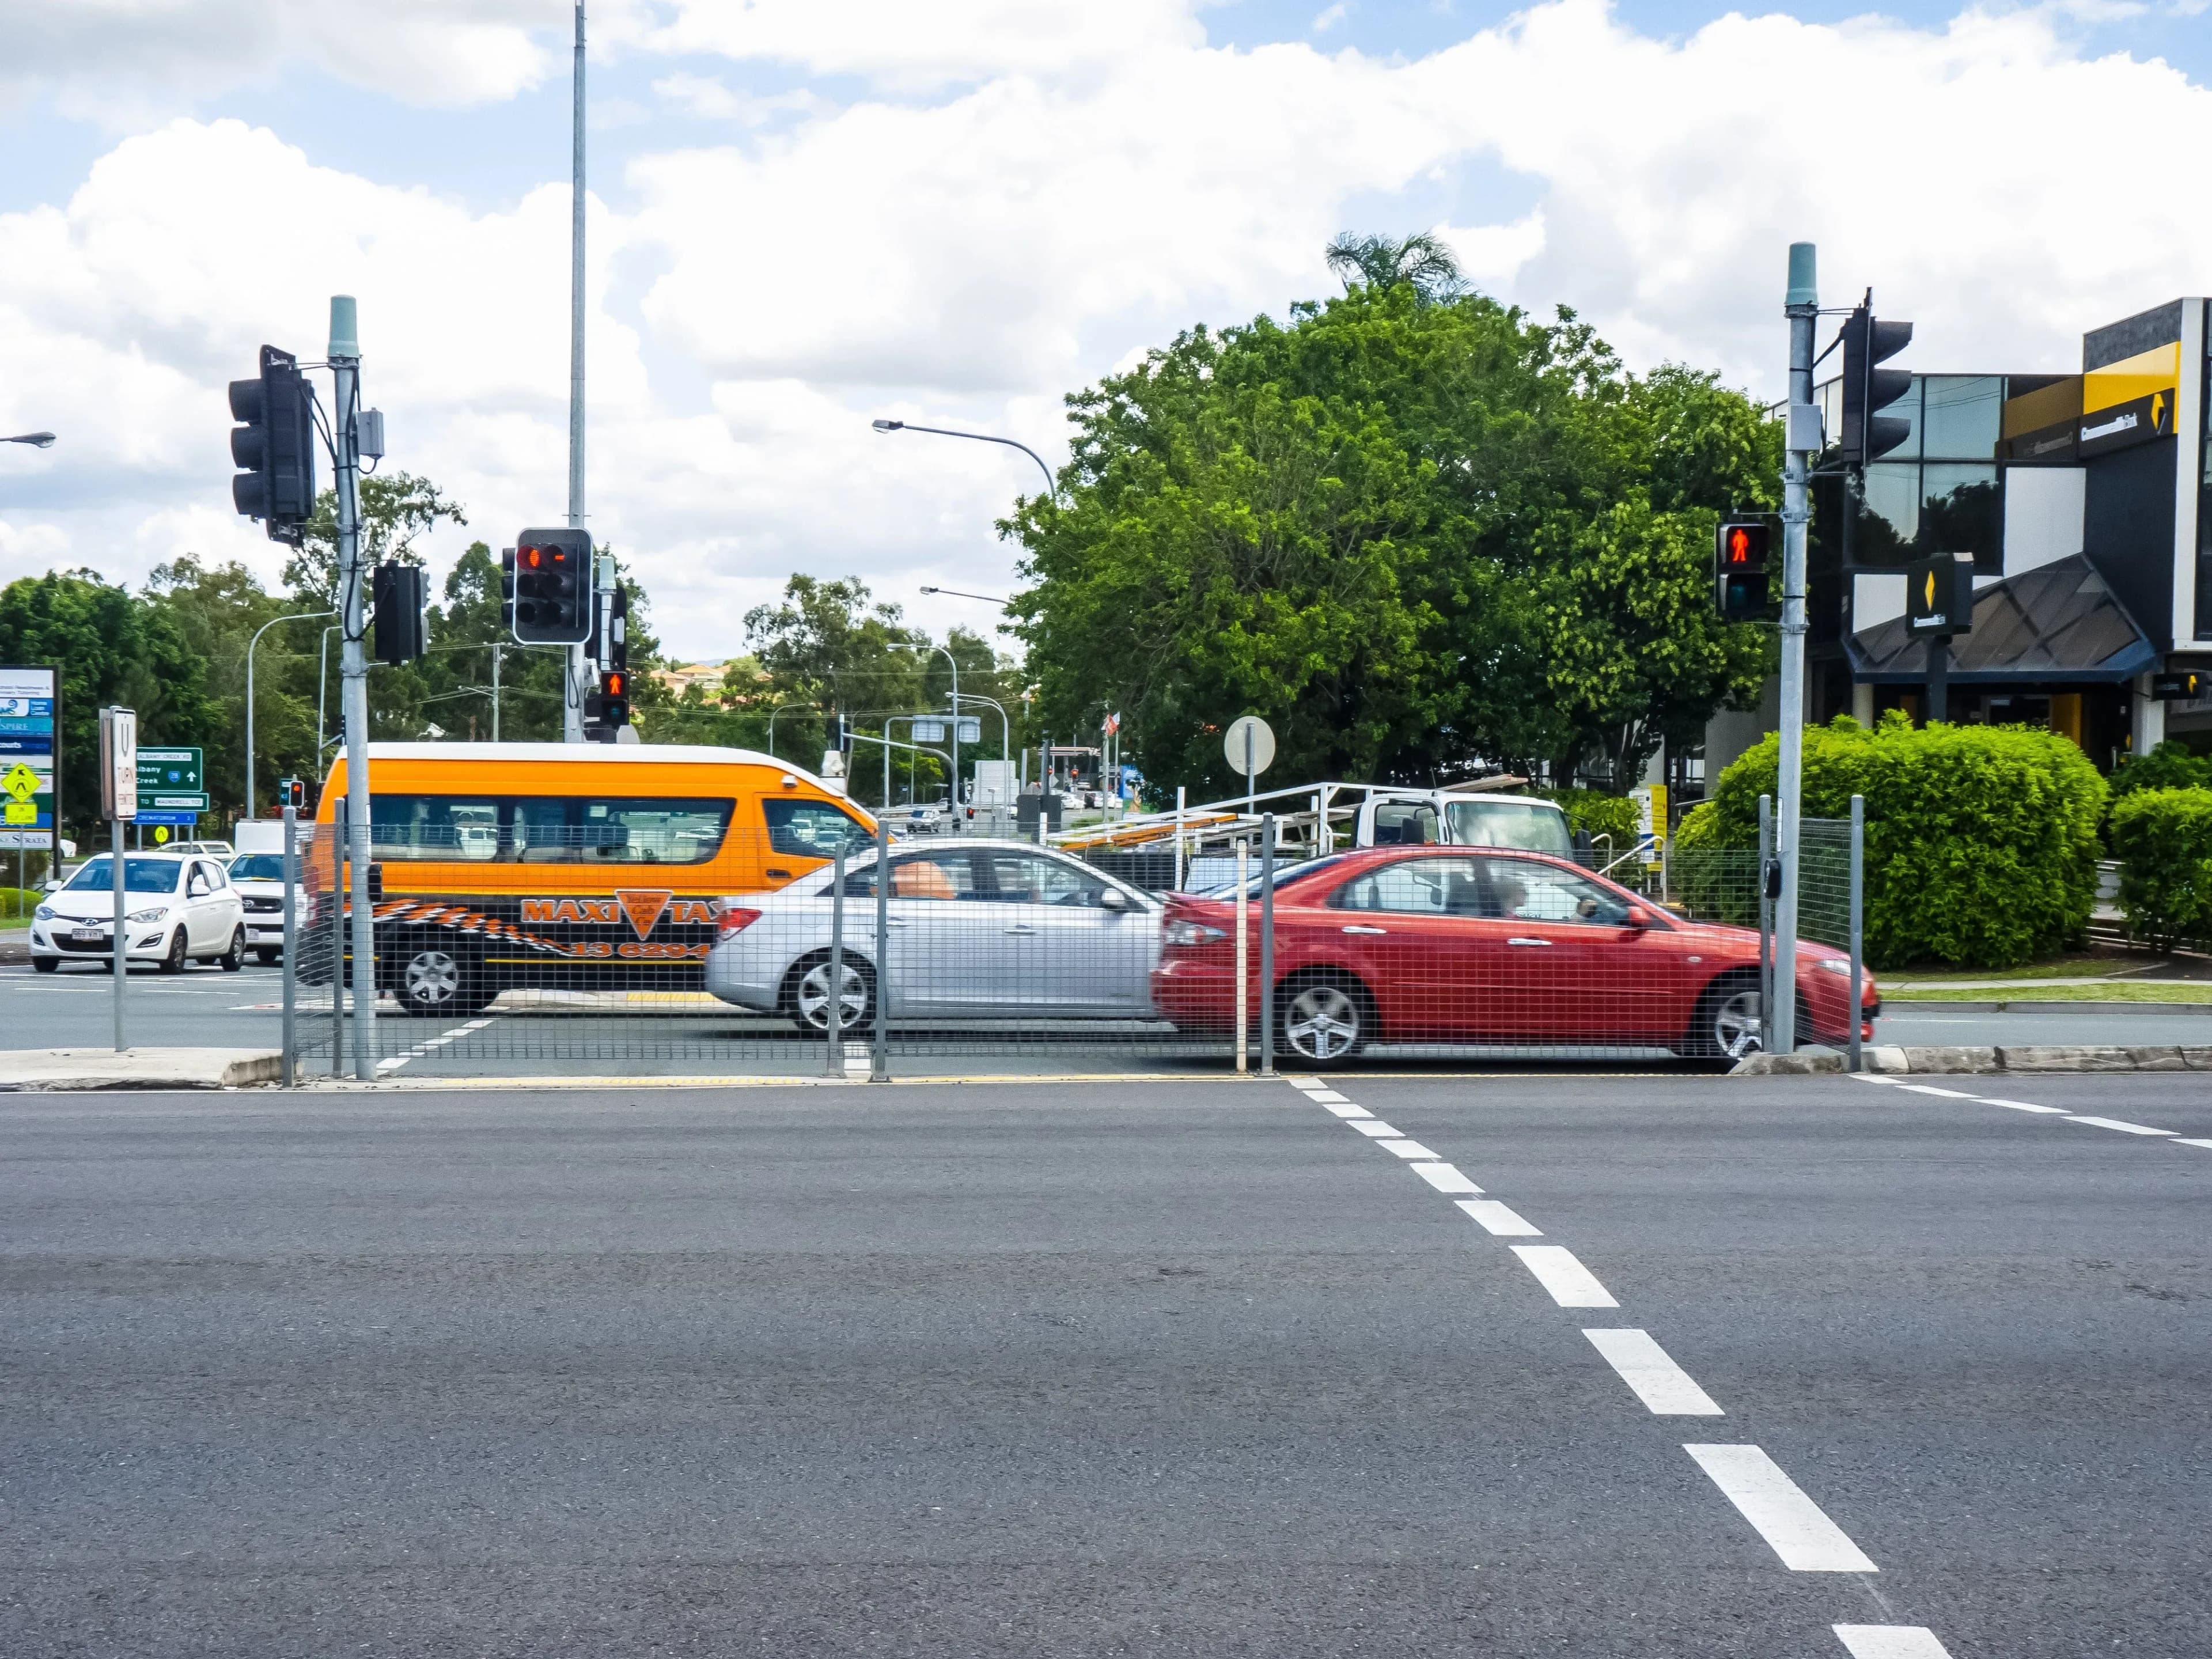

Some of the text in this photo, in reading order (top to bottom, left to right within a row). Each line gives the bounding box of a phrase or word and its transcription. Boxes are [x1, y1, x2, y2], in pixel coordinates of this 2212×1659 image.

[121, 724, 129, 757] U
[521, 899, 720, 924] MAXI TA
[571, 942, 711, 958] 13 6294
